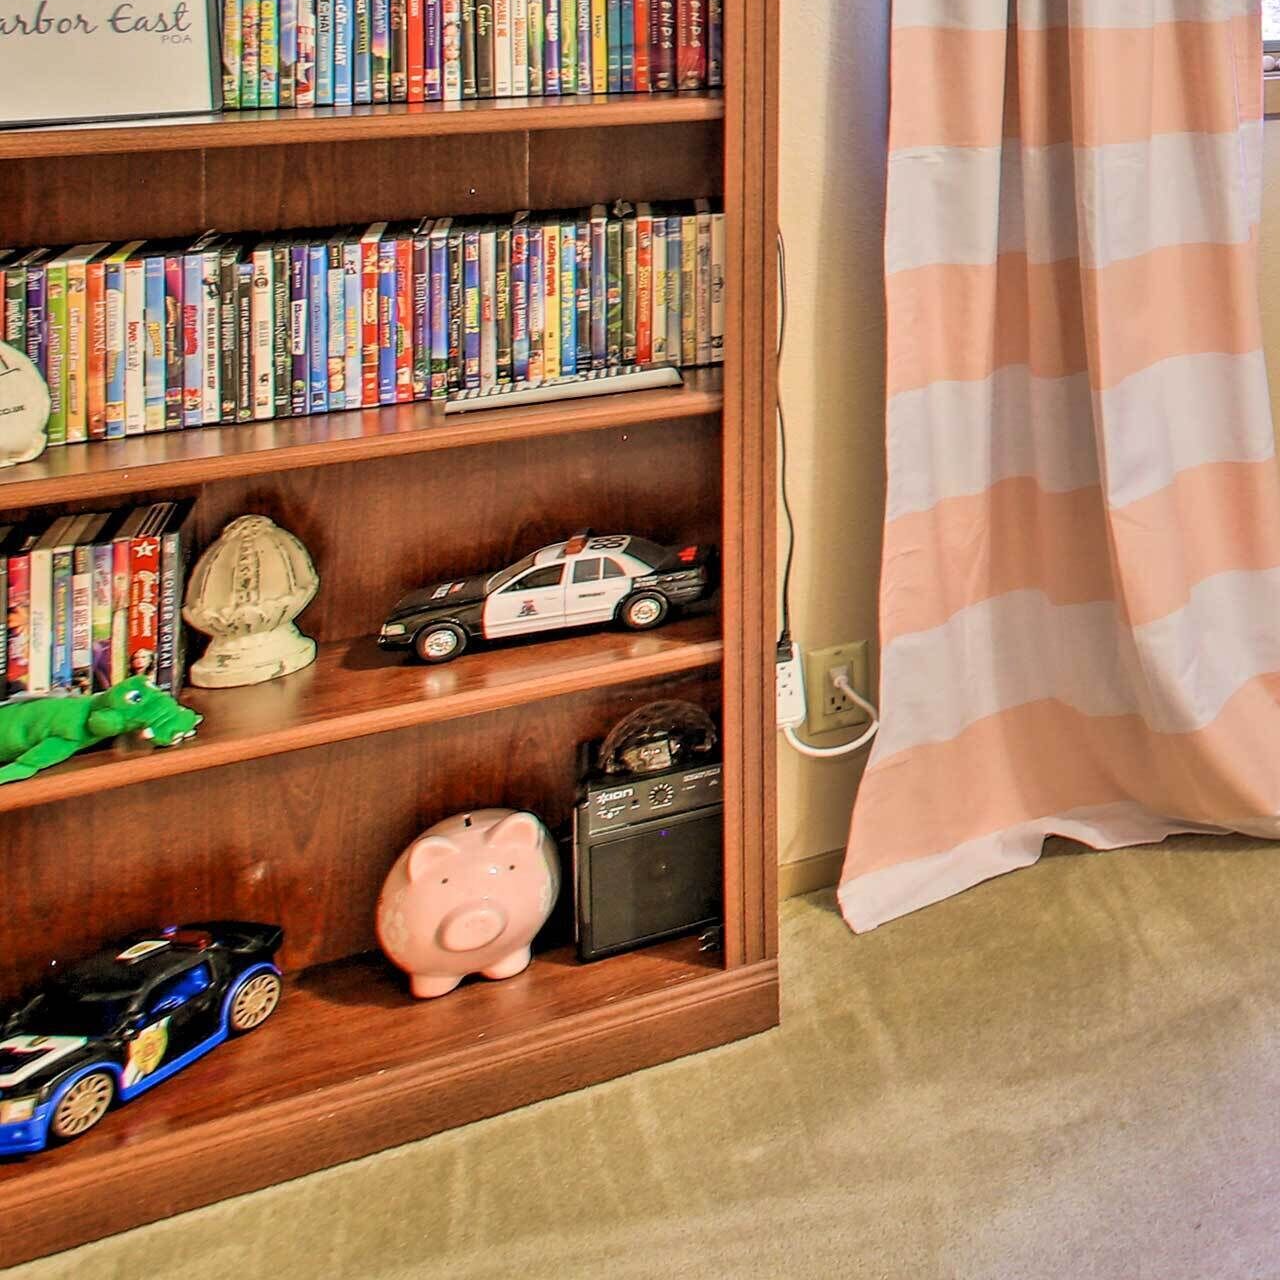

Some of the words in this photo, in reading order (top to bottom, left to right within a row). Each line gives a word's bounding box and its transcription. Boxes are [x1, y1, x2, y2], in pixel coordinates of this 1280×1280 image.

[107, 2, 192, 33] East
[320, 15, 330, 33] HAT
[336, 5, 347, 23] CAT
[162, 34, 192, 44] POA
[335, 45, 346, 65] HAT
[27, 307, 42, 327] Lady
[50, 325, 63, 352] LAND
[128, 321, 139, 342] love
[160, 570, 170, 621] WONDER
[160, 624, 170, 669] WOMAN
